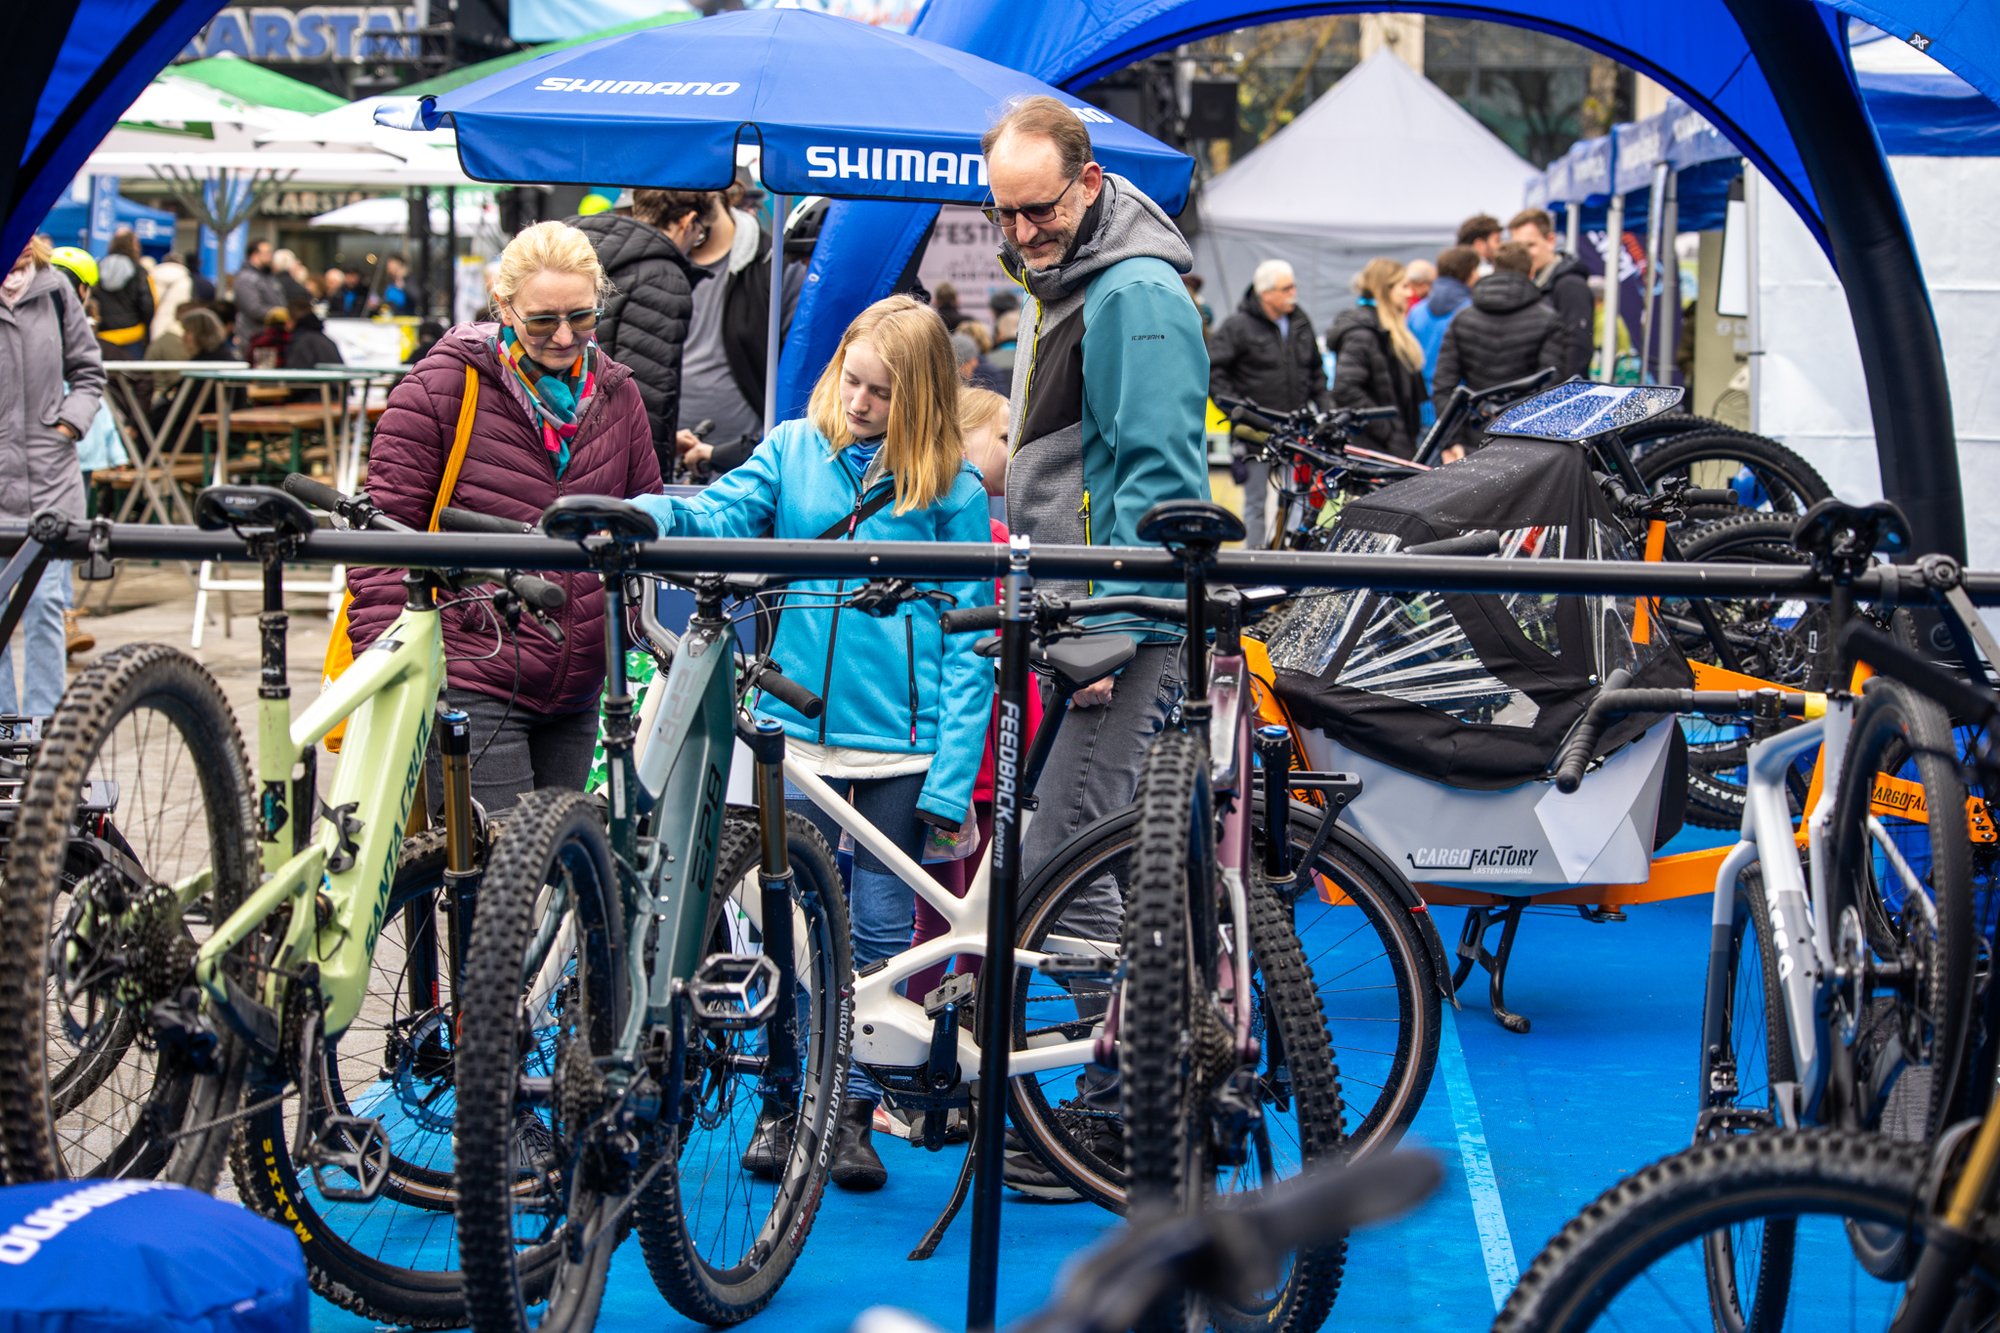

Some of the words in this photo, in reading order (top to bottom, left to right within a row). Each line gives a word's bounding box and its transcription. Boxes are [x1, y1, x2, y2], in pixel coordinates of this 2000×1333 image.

[178, 7, 421, 60] ARSTA
[534, 77, 741, 96] SHIMANO
[806, 145, 989, 186] SHIMAN
[933, 222, 999, 245] FESTI
[996, 700, 1021, 824] FEEDBACK
[1688, 772, 1747, 804] MAXXI
[1872, 785, 1927, 812] ARGOFAC
[365, 821, 404, 968] SANTA
[401, 709, 430, 826] CRUZ
[993, 822, 1006, 868] SPORTS
[1473, 867, 1533, 875] LASTENFAHRRAD
[818, 1063, 845, 1168] MARTELLO
[262, 1138, 313, 1243] MAXXIS
